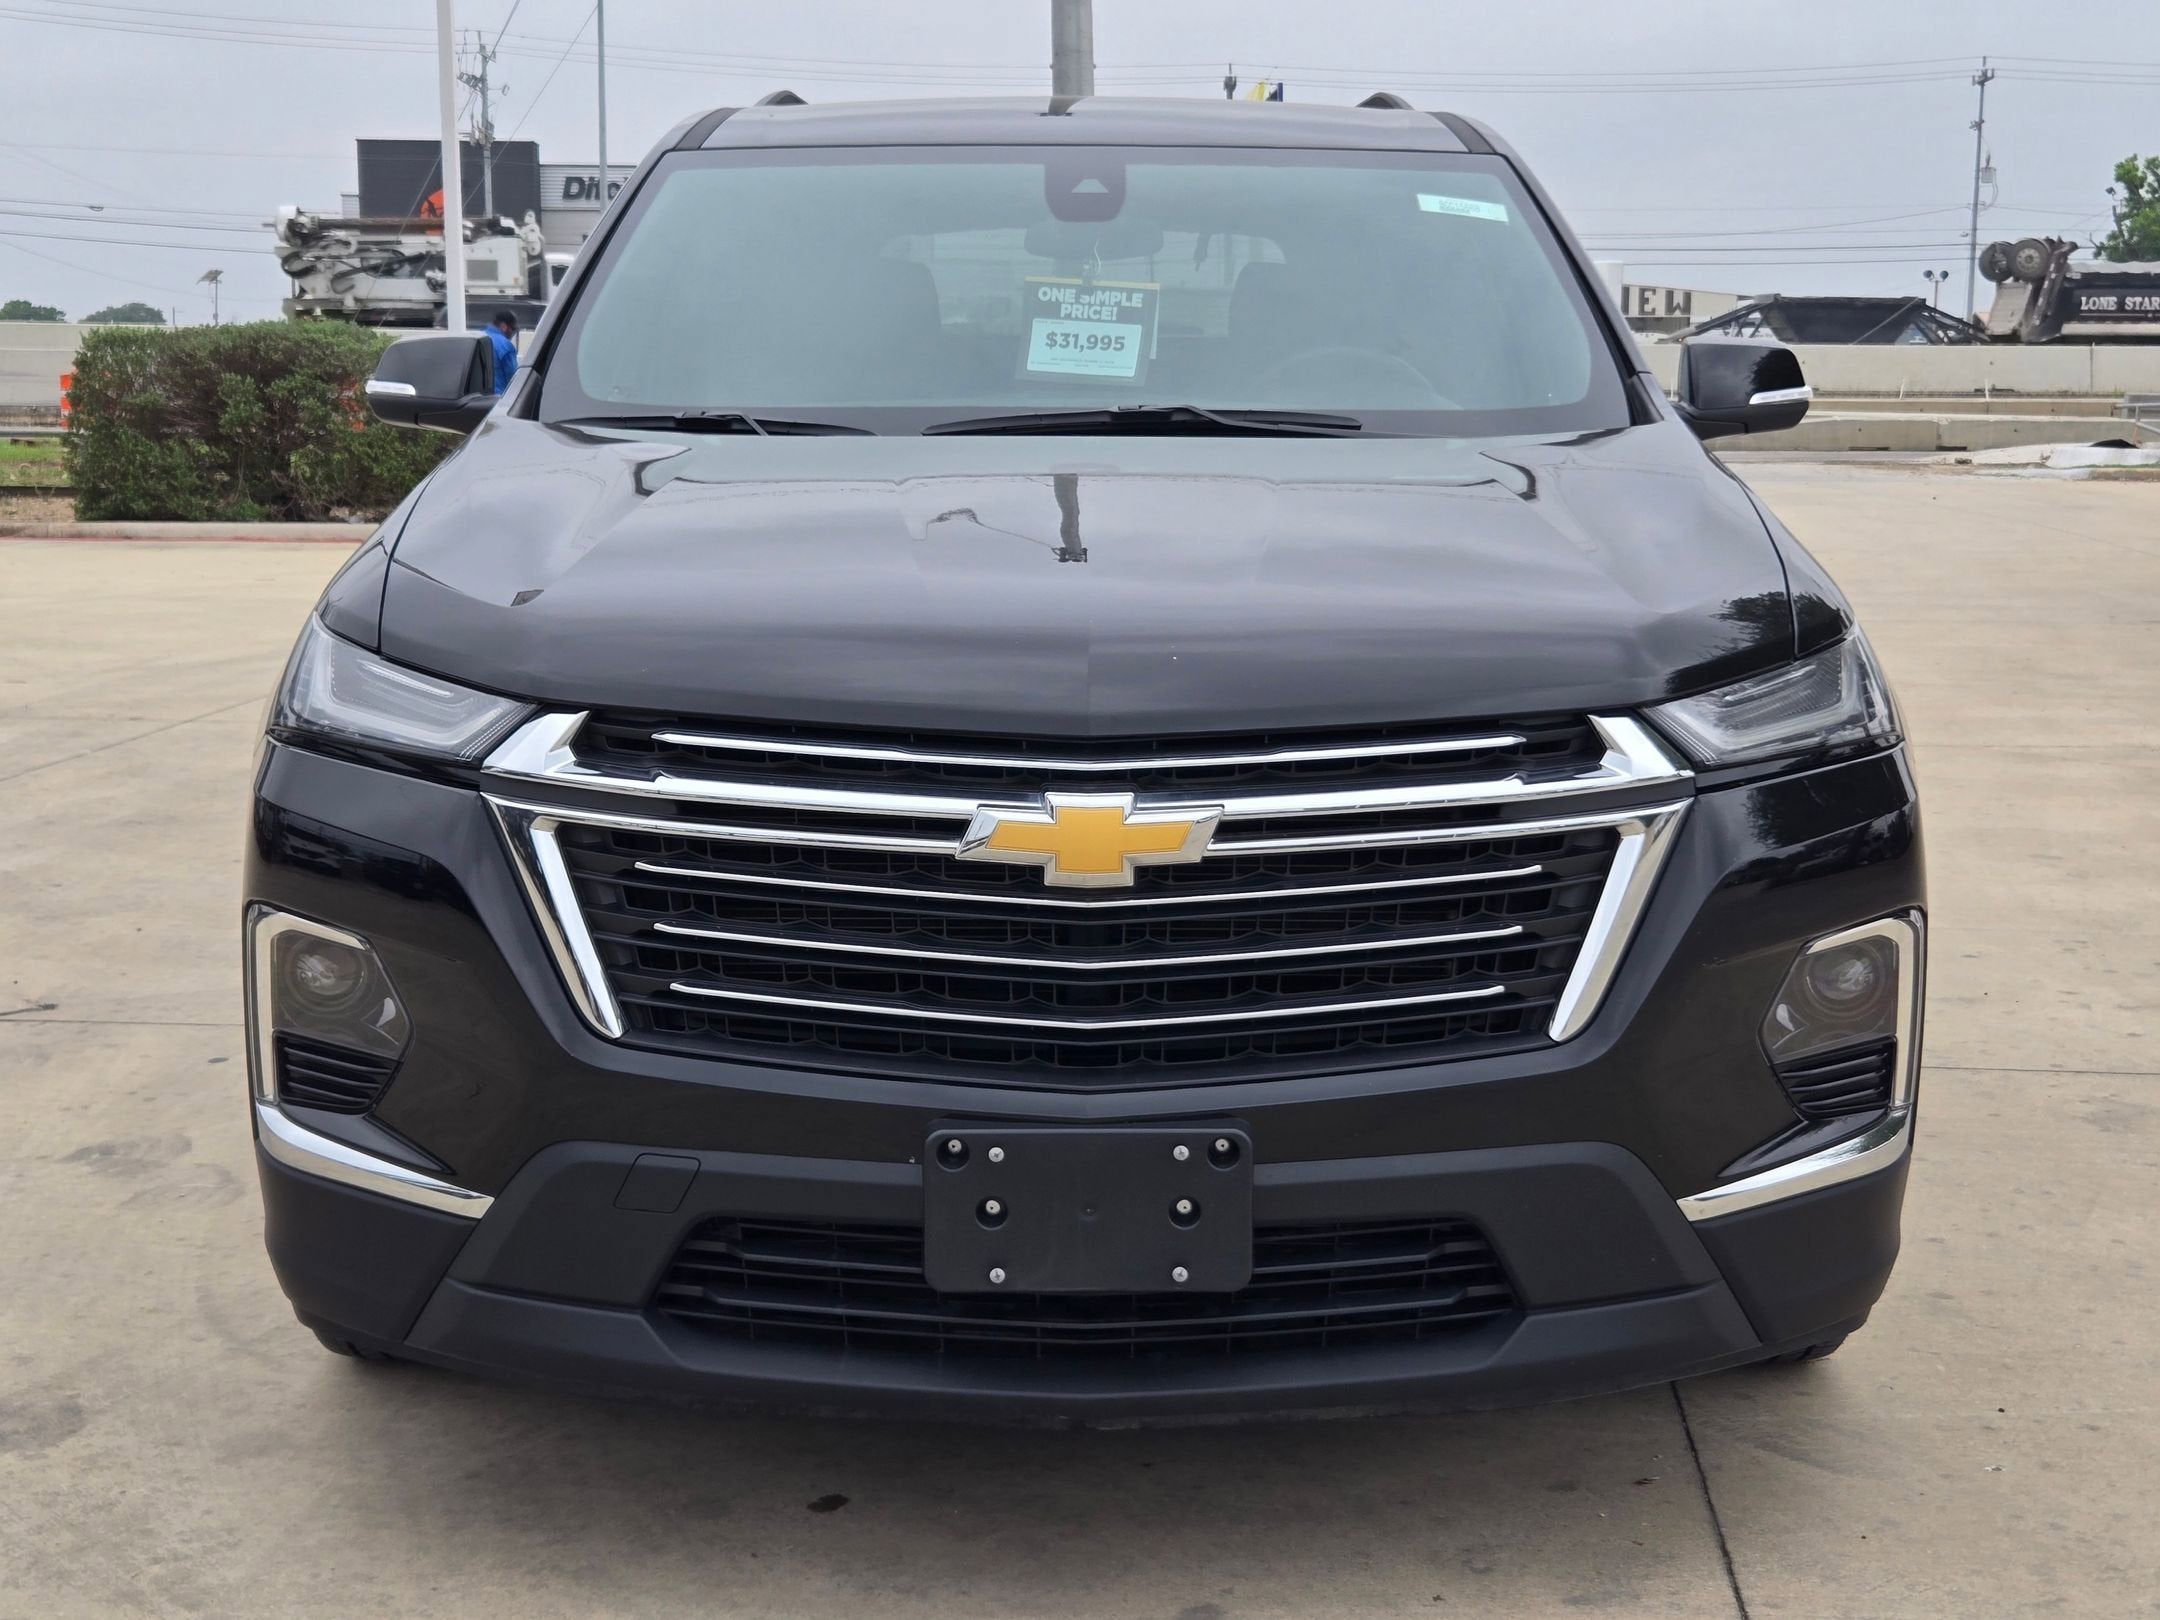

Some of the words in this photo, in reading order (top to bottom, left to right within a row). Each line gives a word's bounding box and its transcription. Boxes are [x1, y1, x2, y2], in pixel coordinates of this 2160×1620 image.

[1038, 287, 1077, 303] ONE
[2080, 296, 2117, 310] LONE
[2124, 296, 2160, 310] STAR
[1060, 304, 1118, 320] PRICE!
[1045, 331, 1125, 352] $31,995
